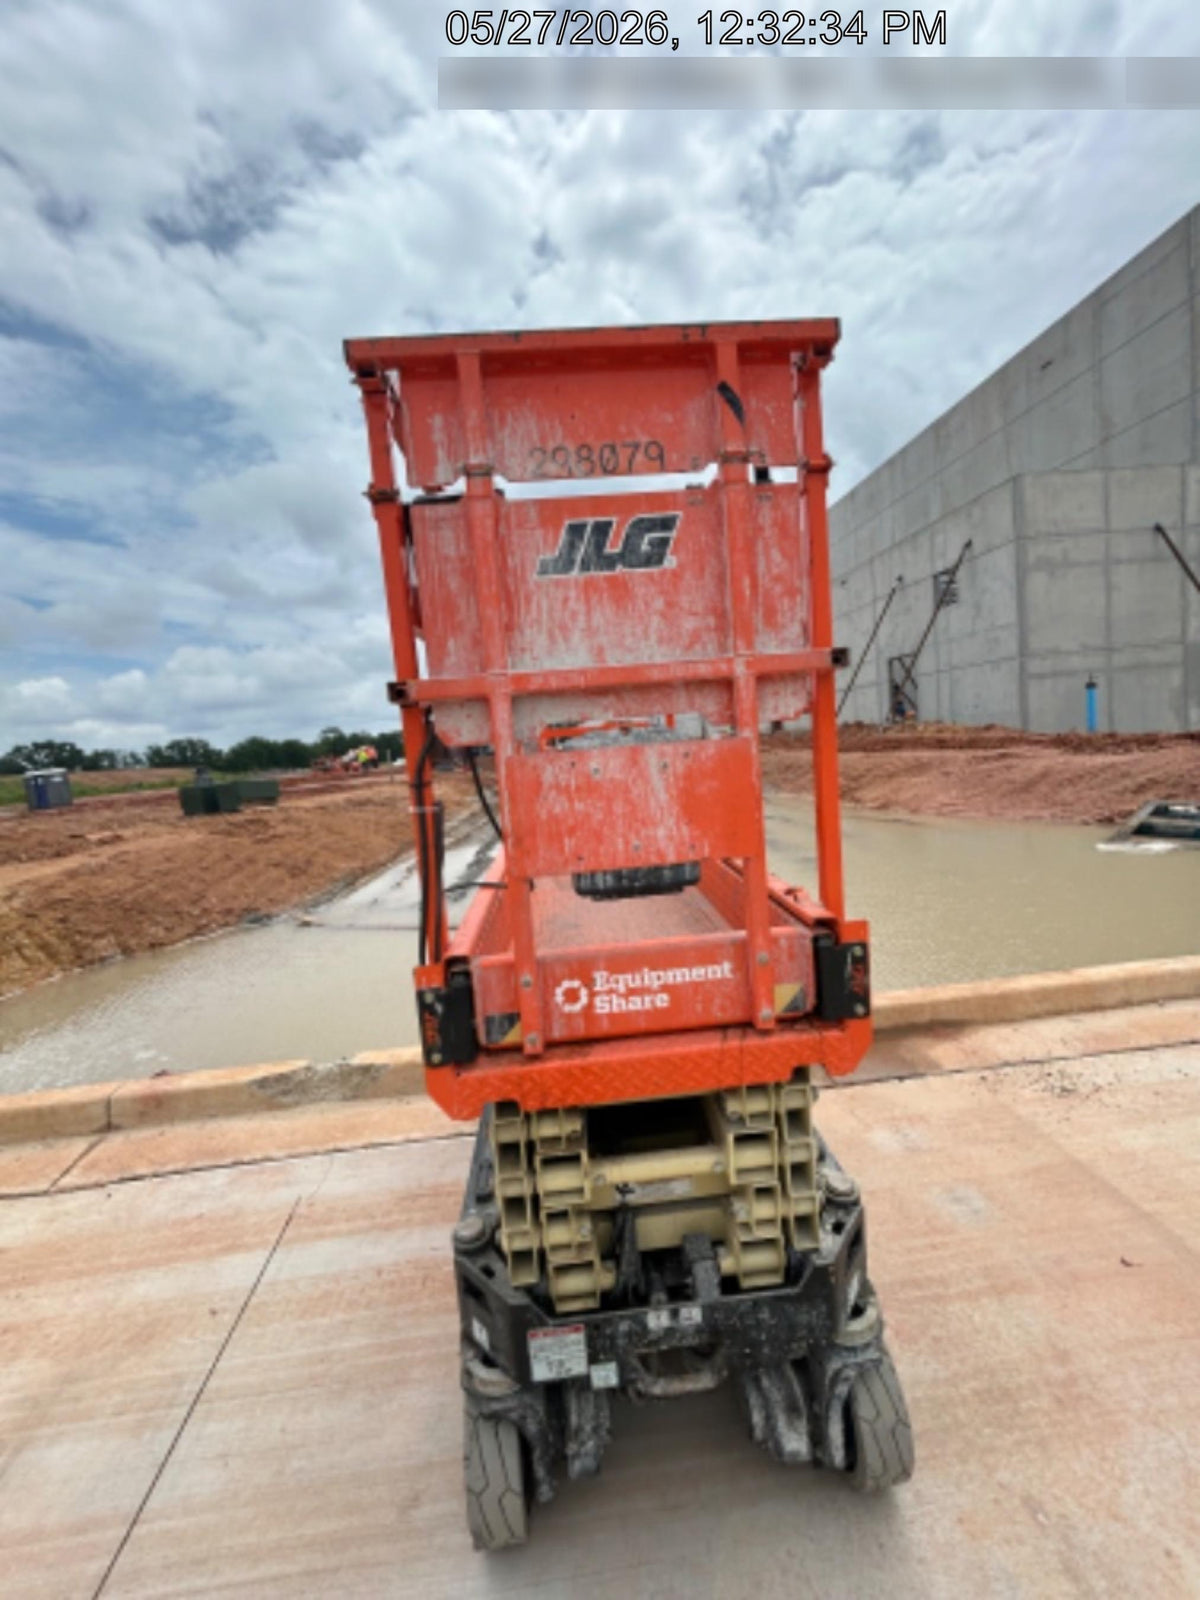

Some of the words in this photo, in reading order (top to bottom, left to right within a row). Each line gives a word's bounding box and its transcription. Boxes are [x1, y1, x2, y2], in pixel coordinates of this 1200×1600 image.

[529, 440, 666, 478] 298079
[535, 510, 683, 578] JLG
[593, 961, 734, 992] Equipment
[593, 992, 670, 1014] Share
